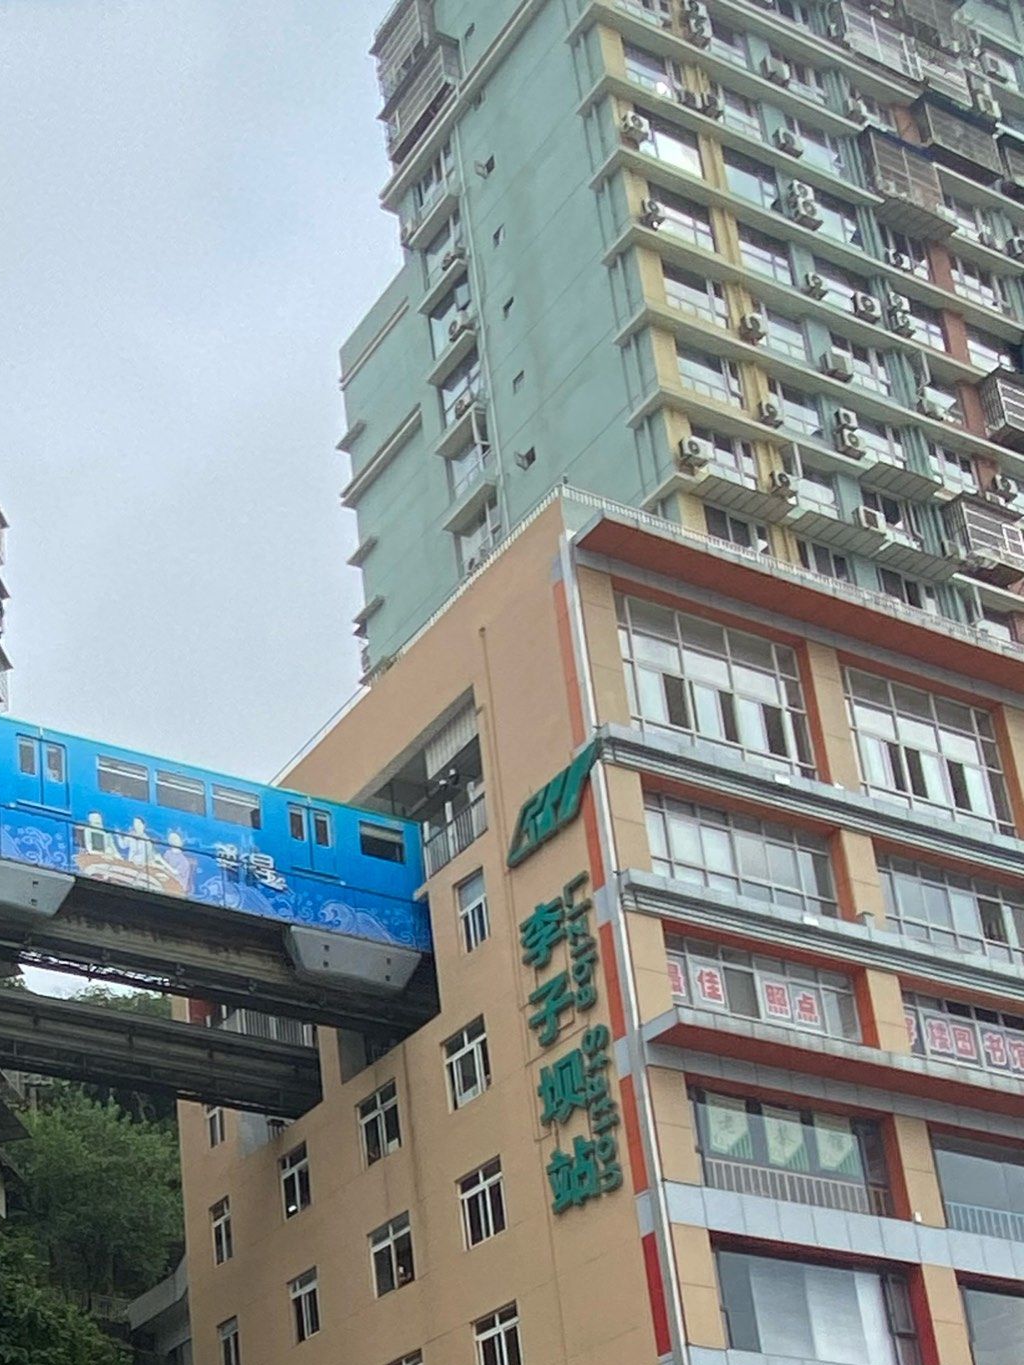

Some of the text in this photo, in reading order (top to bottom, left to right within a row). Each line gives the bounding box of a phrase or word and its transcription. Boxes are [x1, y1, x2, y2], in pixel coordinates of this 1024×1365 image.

[519, 896, 601, 1215] 李子坝站
[582, 1023, 624, 1193] Station
